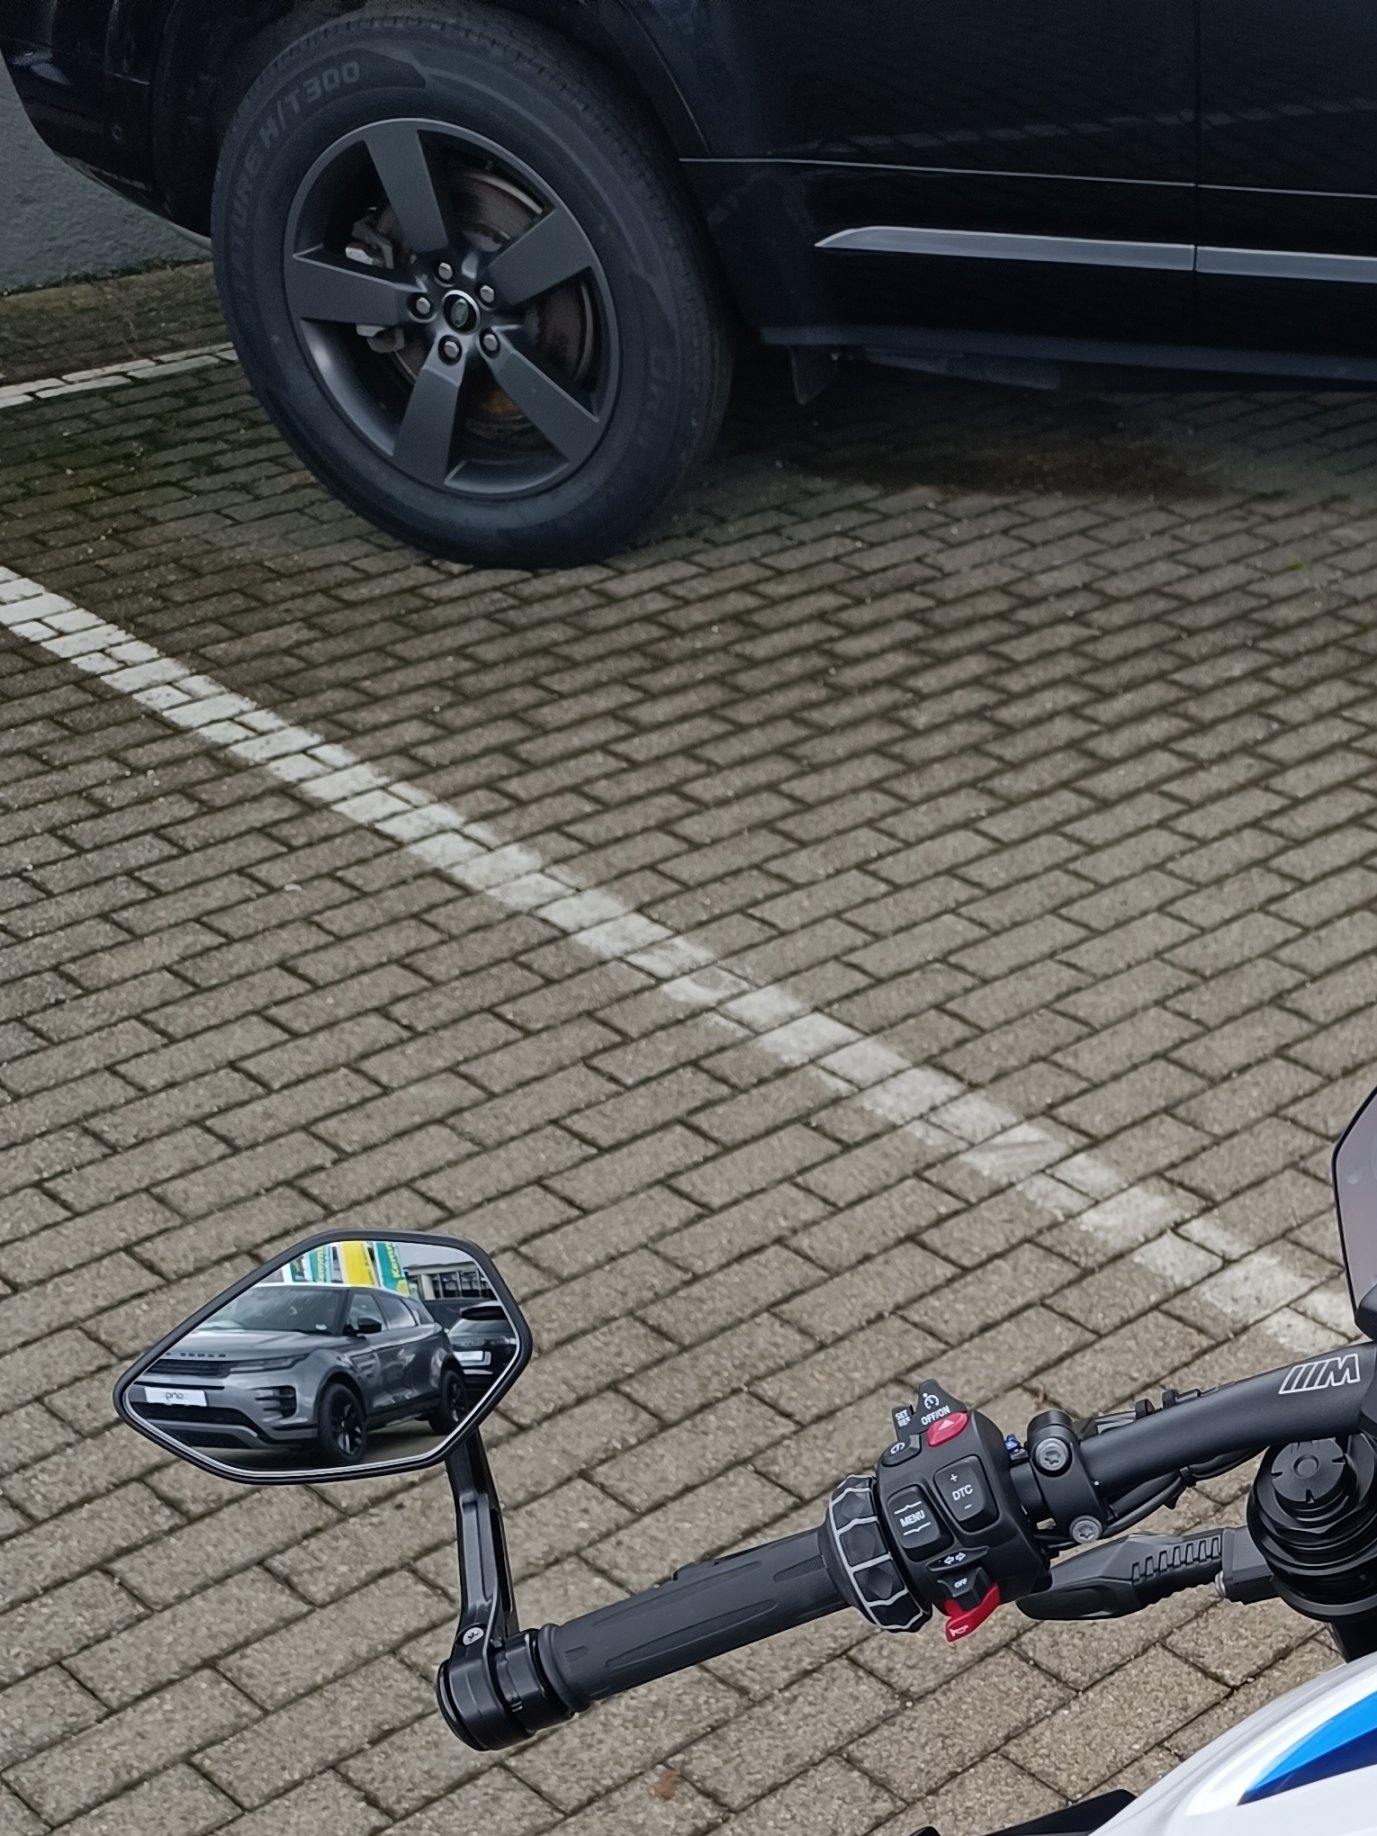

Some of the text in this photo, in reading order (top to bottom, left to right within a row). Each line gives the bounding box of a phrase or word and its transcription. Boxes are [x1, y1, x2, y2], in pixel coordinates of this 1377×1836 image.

[258, 60, 361, 149] H/T300
[920, 1404, 951, 1426] OFF/ON
[952, 1484, 973, 1501] DTC
[900, 1509, 926, 1528] MENU
[954, 1577, 968, 1589] OFF
